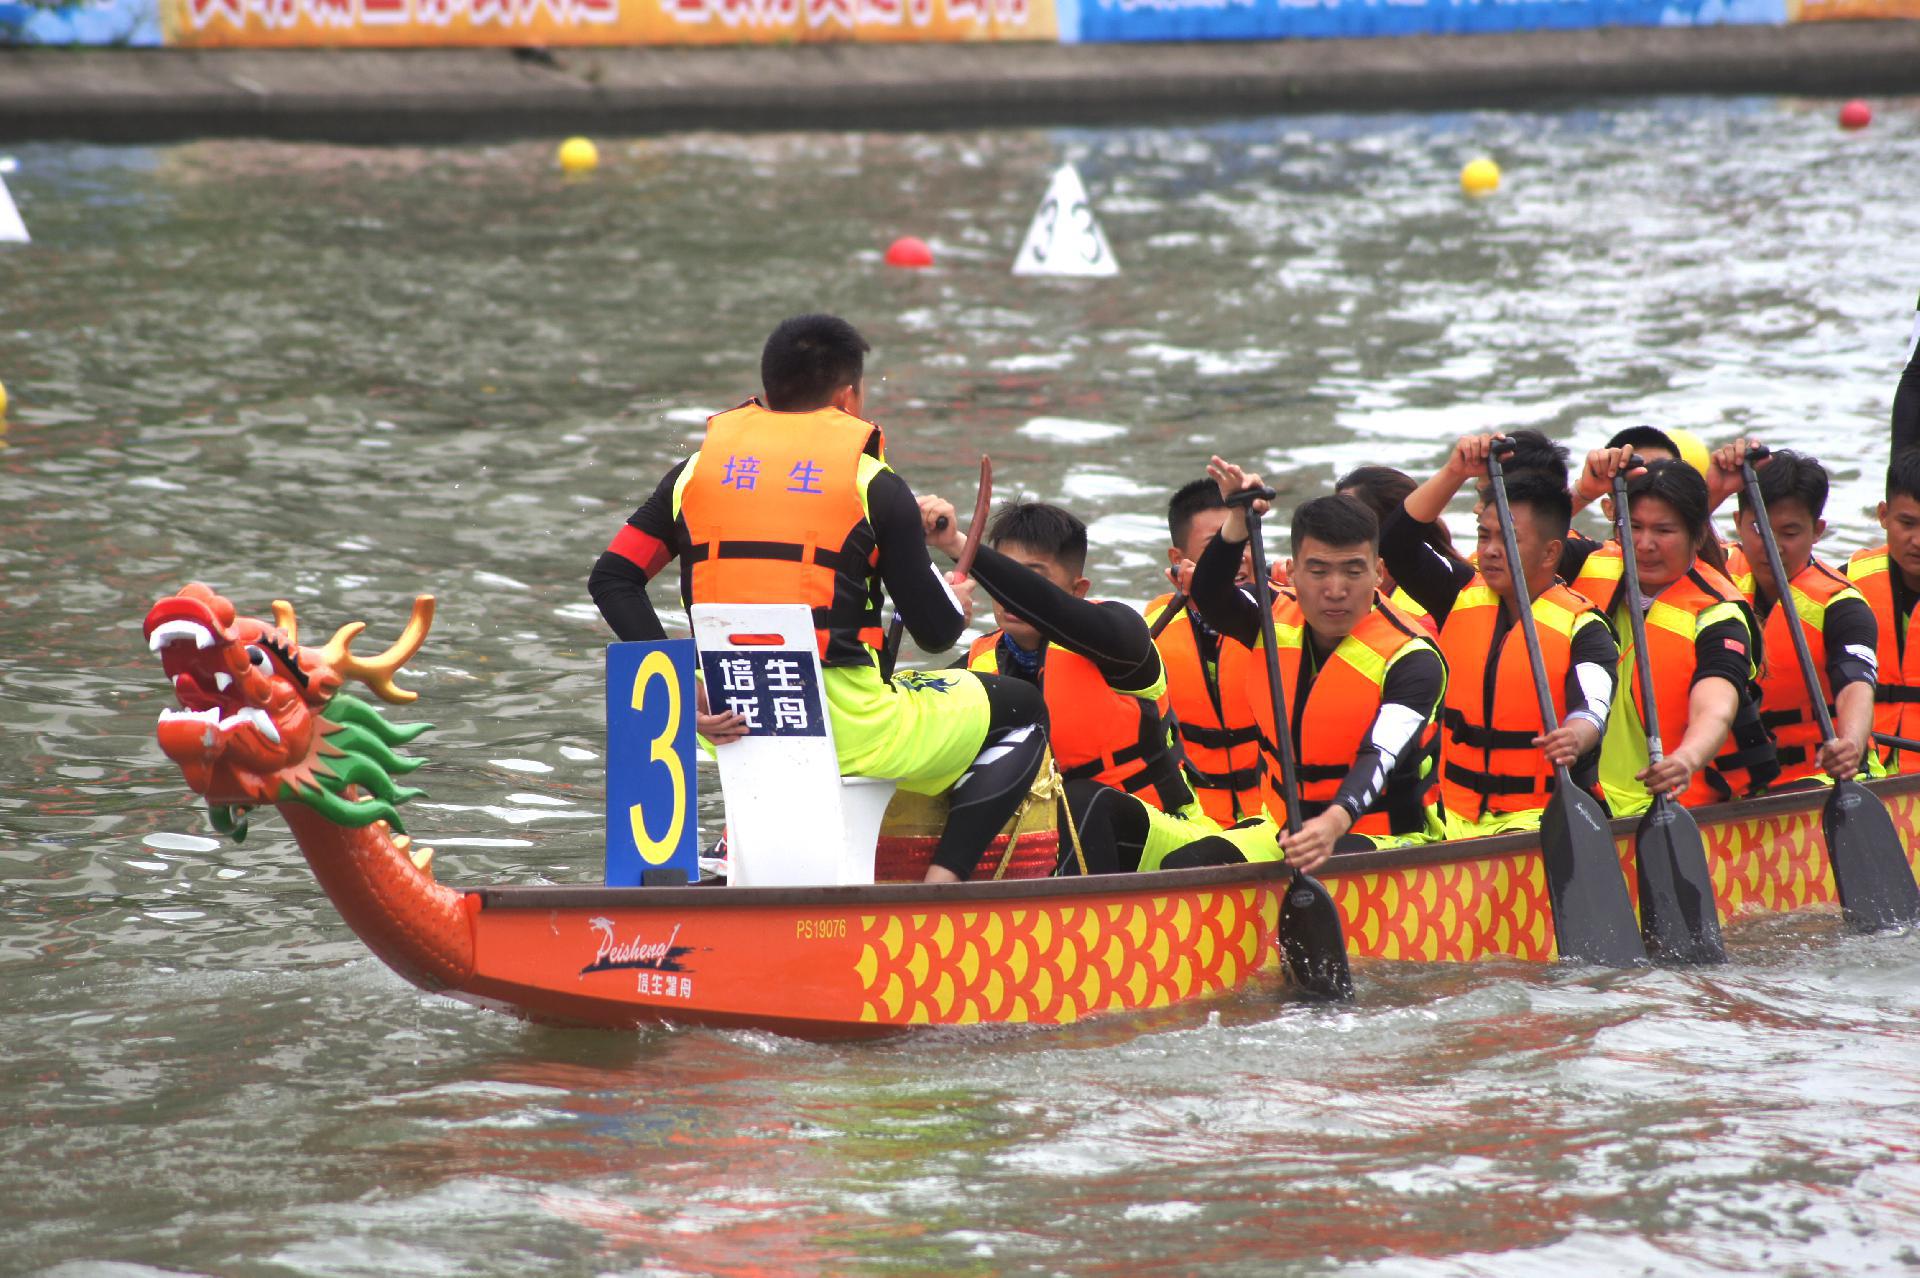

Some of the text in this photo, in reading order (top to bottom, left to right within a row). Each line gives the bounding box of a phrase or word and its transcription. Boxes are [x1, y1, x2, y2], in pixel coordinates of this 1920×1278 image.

[1071, 202, 1101, 264] 3
[721, 455, 824, 494] 培生
[719, 658, 803, 691] 培生
[725, 696, 808, 729] 龙舟
[629, 650, 687, 865] 3
[588, 916, 682, 968] Peisheng
[796, 919, 847, 939] PS19076
